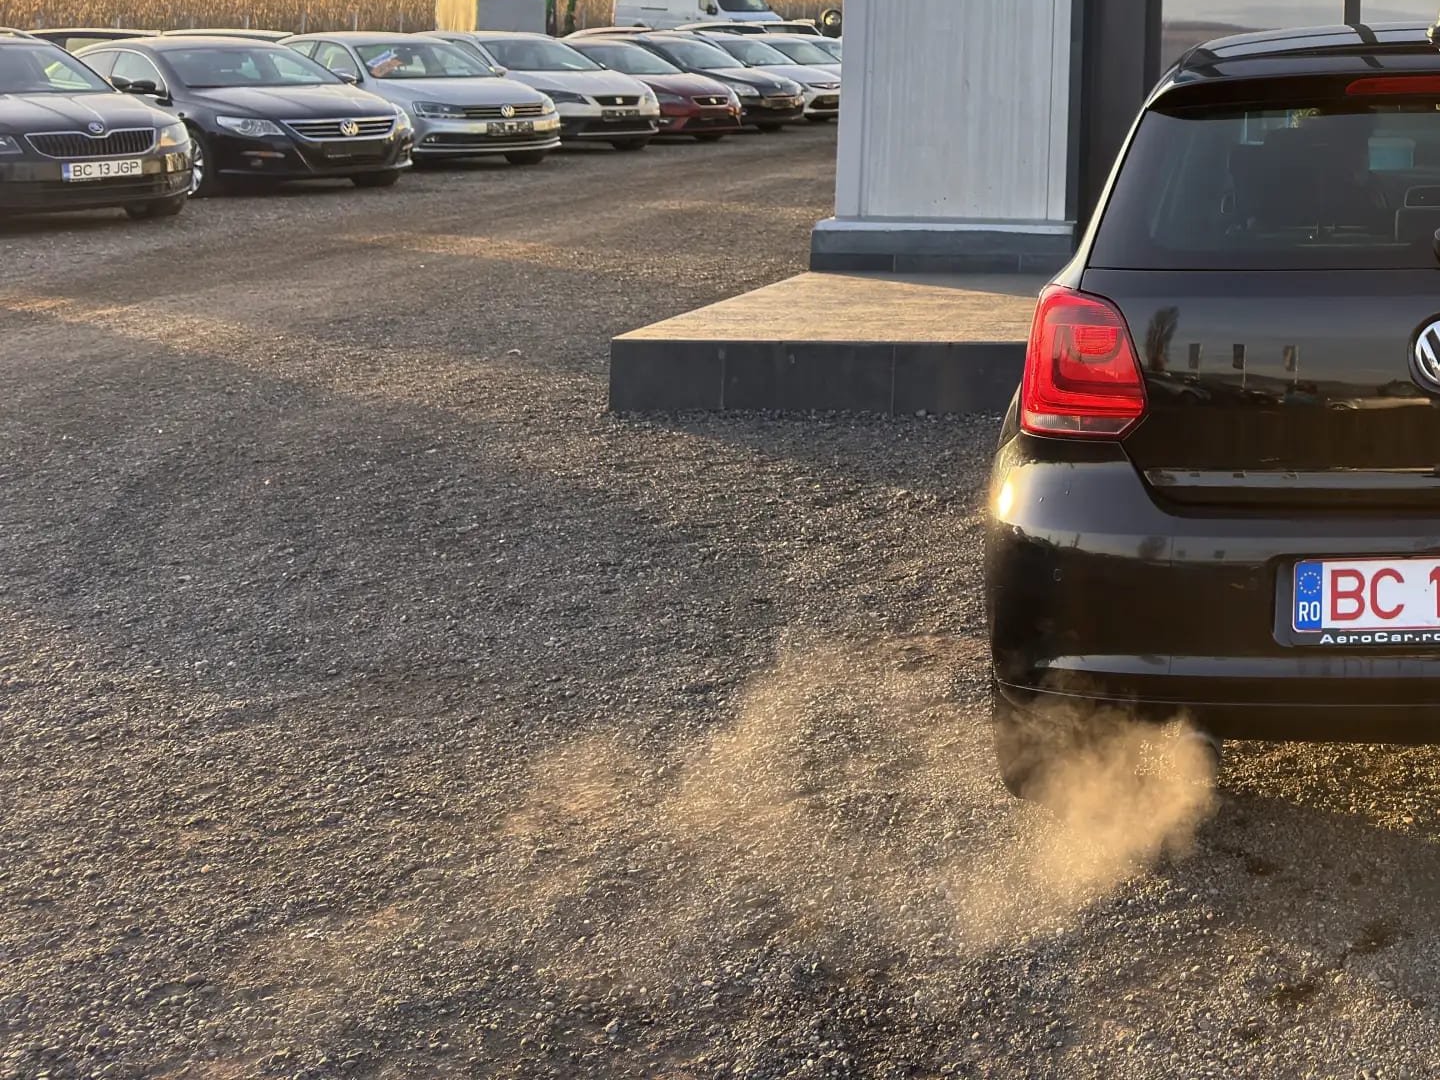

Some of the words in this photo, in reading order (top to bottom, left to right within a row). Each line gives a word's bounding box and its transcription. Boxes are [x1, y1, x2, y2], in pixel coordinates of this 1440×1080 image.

[72, 164, 93, 177] BC
[98, 163, 111, 175] 13
[114, 161, 139, 174] JGP
[1298, 601, 1321, 621] RO
[1330, 568, 1405, 621] BC
